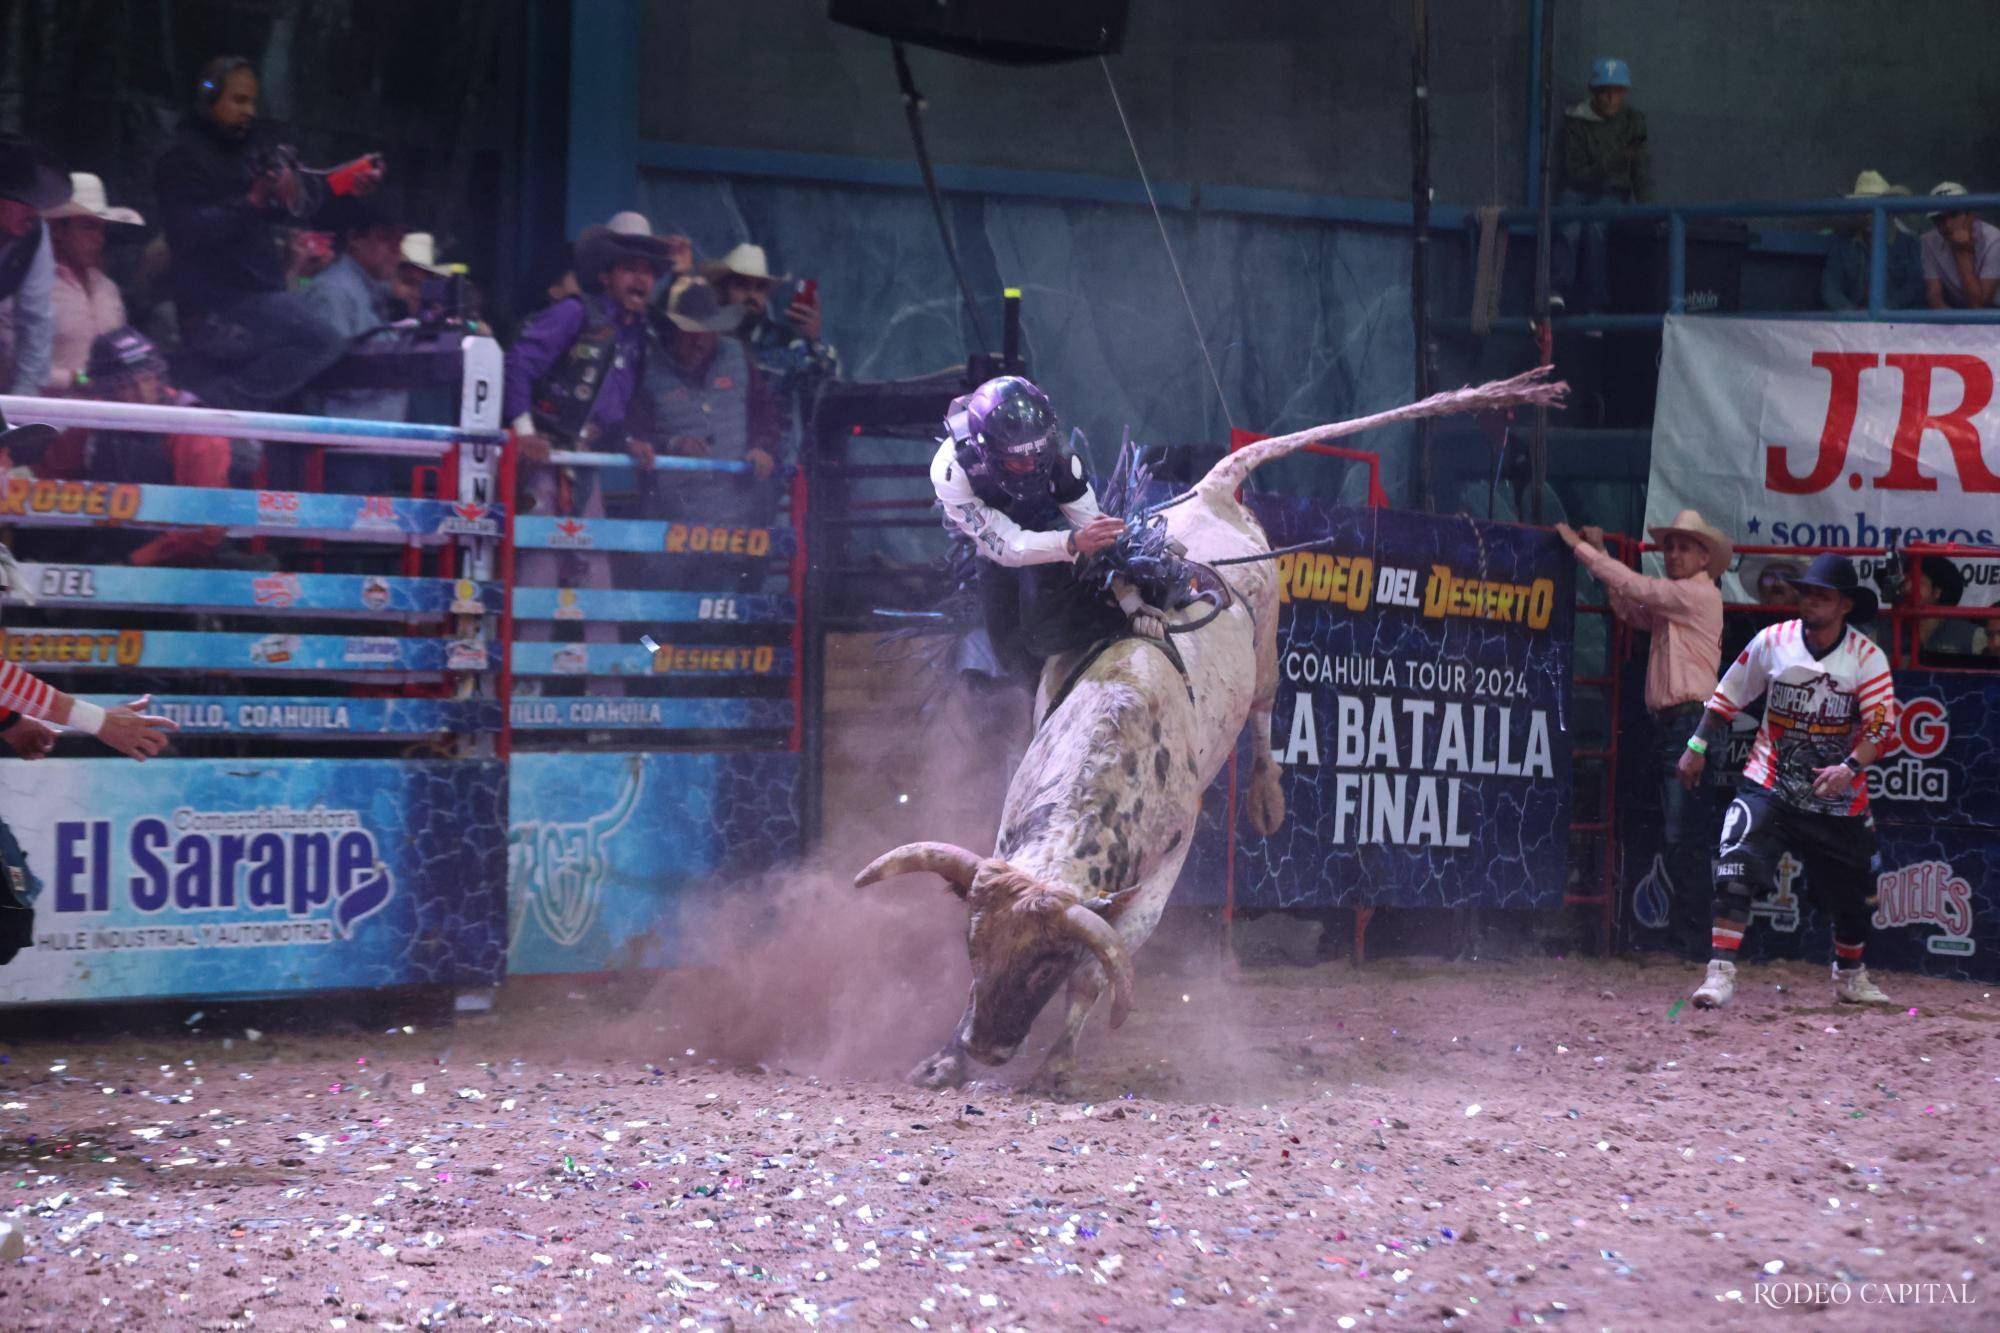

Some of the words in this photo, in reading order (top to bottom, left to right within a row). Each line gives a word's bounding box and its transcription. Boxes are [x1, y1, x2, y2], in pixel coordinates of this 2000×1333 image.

[0, 479, 141, 519] RODEO
[666, 523, 770, 557] RODEO
[1772, 512, 1994, 548] sombreros
[41, 568, 95, 597] DEL
[1278, 551, 1373, 612] RODEO
[1376, 566, 1420, 608] DEL
[1424, 564, 1554, 630] DESIERTO
[699, 599, 738, 620] DEL
[654, 644, 774, 673] DESIERTO
[1286, 652, 1396, 687] COAHUILA
[1405, 661, 1467, 693] TOUR
[1476, 667, 1528, 698] 2024
[569, 702, 662, 725] COAHUILA
[1772, 684, 1809, 714] SUPER
[239, 705, 349, 729] COAHUILA
[1337, 694, 1554, 778] BATALLA
[176, 807, 358, 831] Comercializadora
[1333, 773, 1470, 847] FINAL
[55, 820, 110, 912] El
[130, 818, 378, 916] Sarape
[1874, 863, 1969, 935] RIELES
[38, 932, 86, 950] HULE
[92, 928, 198, 949] INDUSTRIAL
[202, 927, 214, 946] Y
[217, 922, 330, 945] AUTOMOTRIZ
